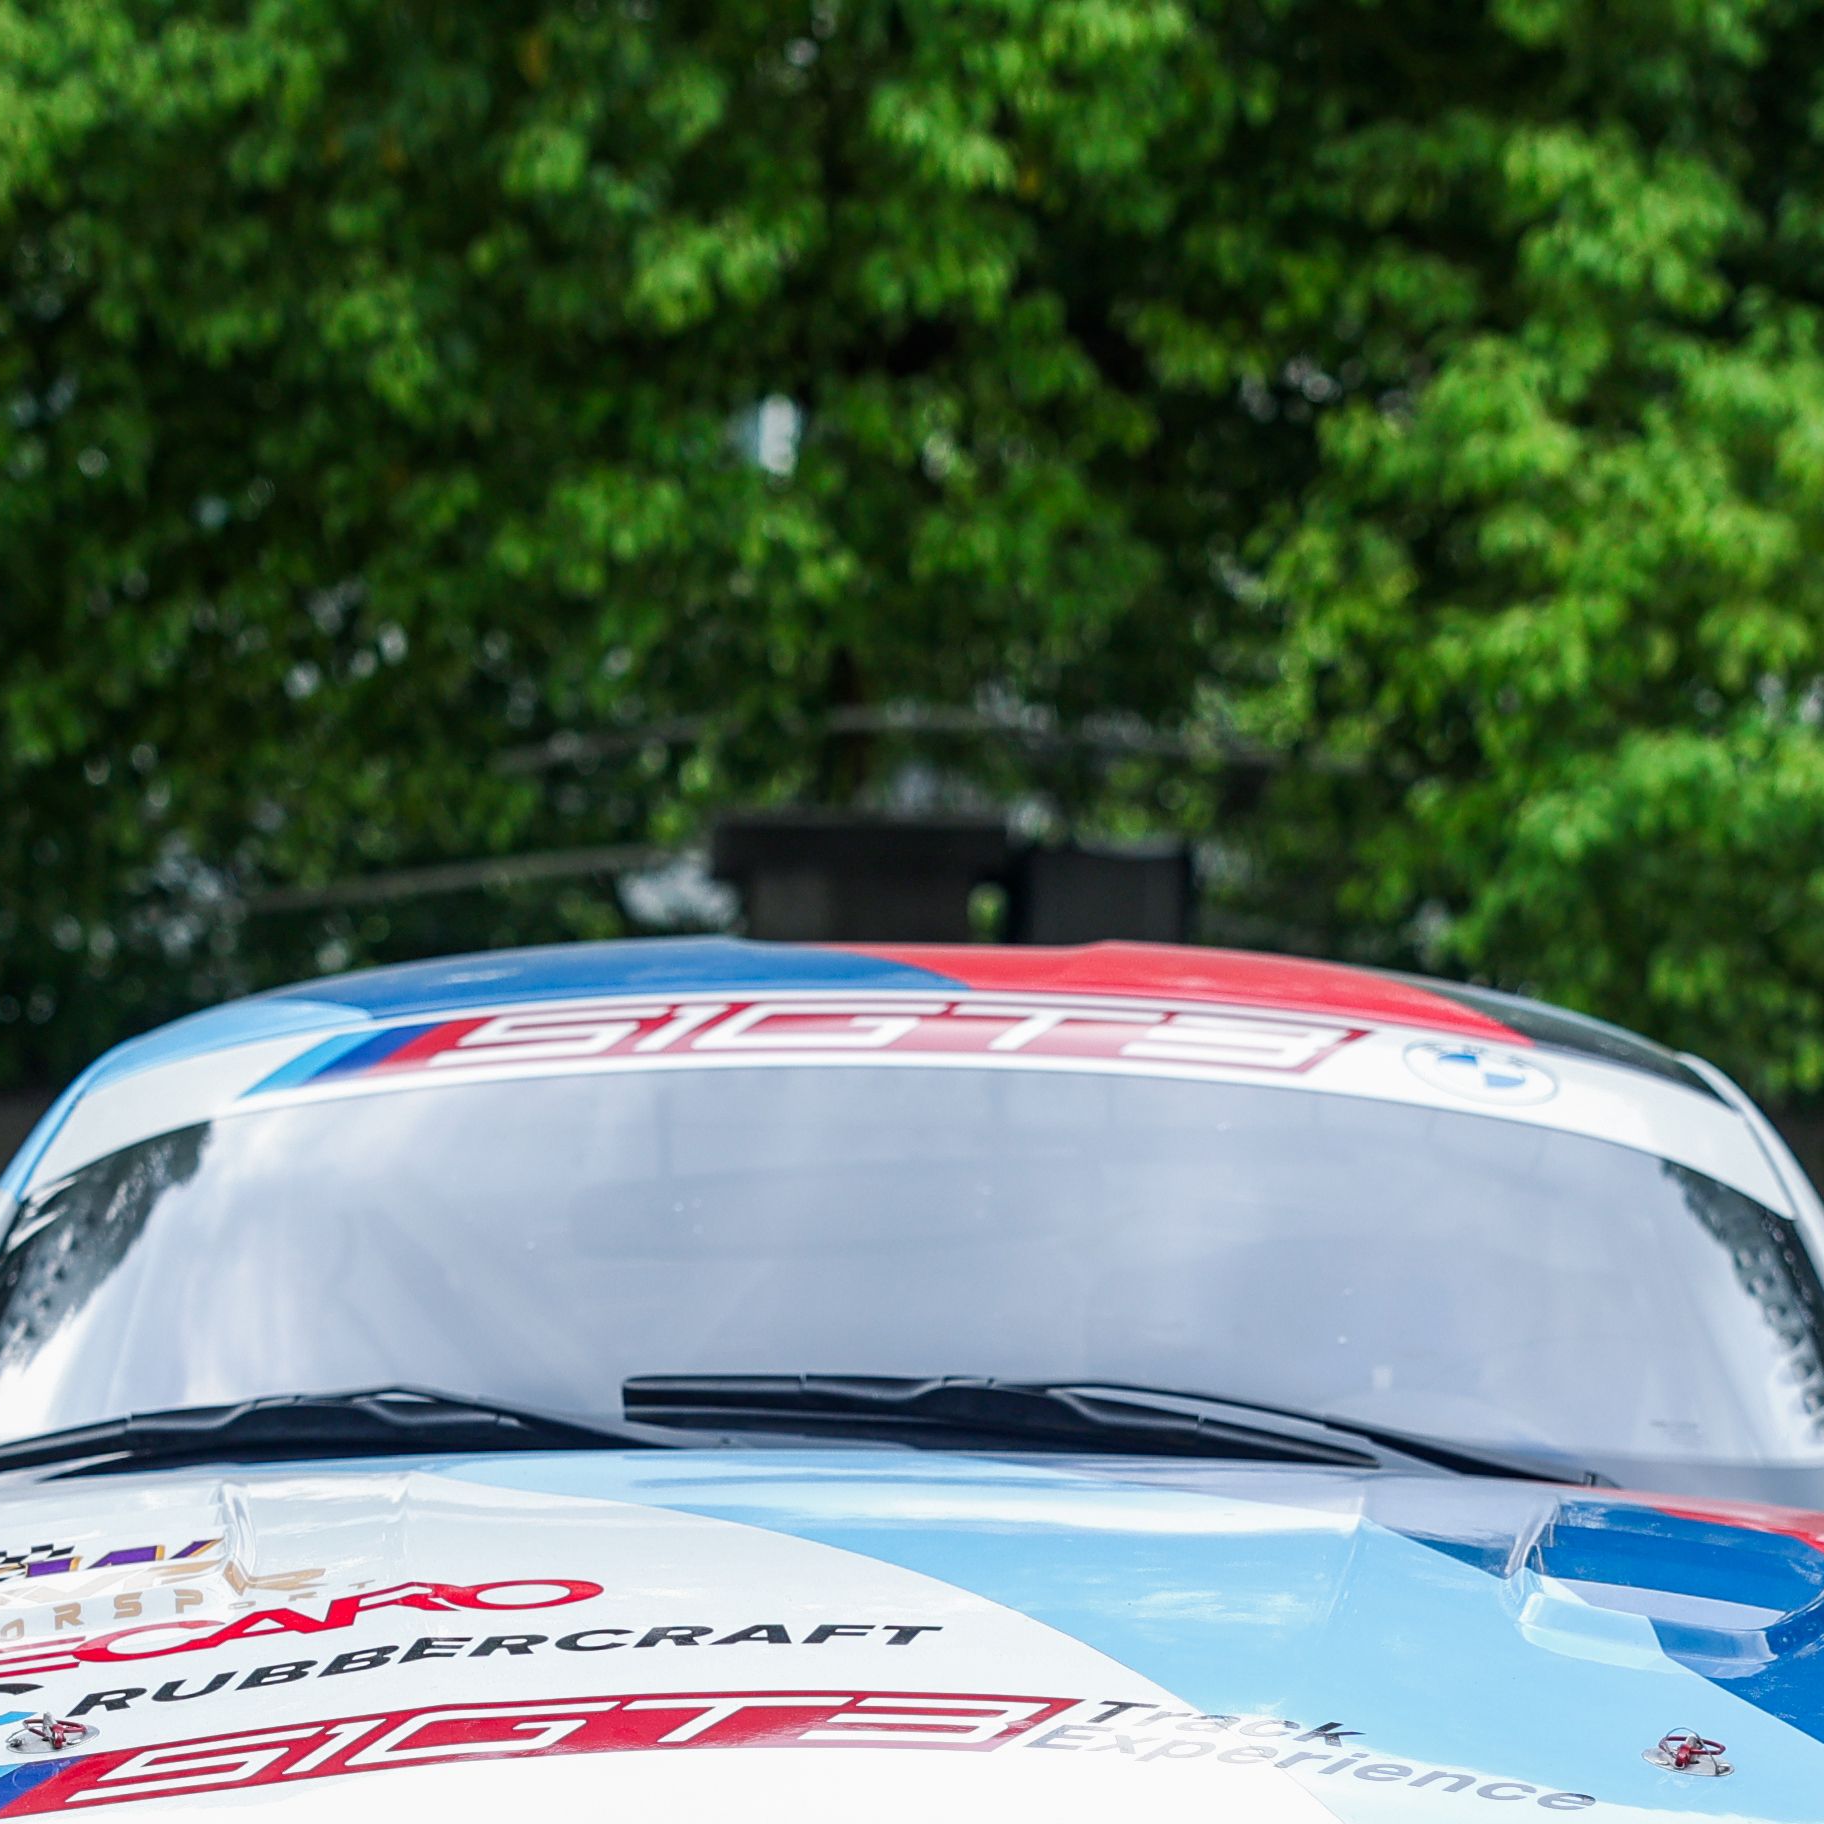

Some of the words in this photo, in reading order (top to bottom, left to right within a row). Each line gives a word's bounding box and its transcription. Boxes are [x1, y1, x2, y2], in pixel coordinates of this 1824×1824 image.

[66, 1624, 944, 1717] RUBBERCRAFT
[1087, 1700, 1366, 1747] Track
[1027, 1724, 1598, 1811] Experience
